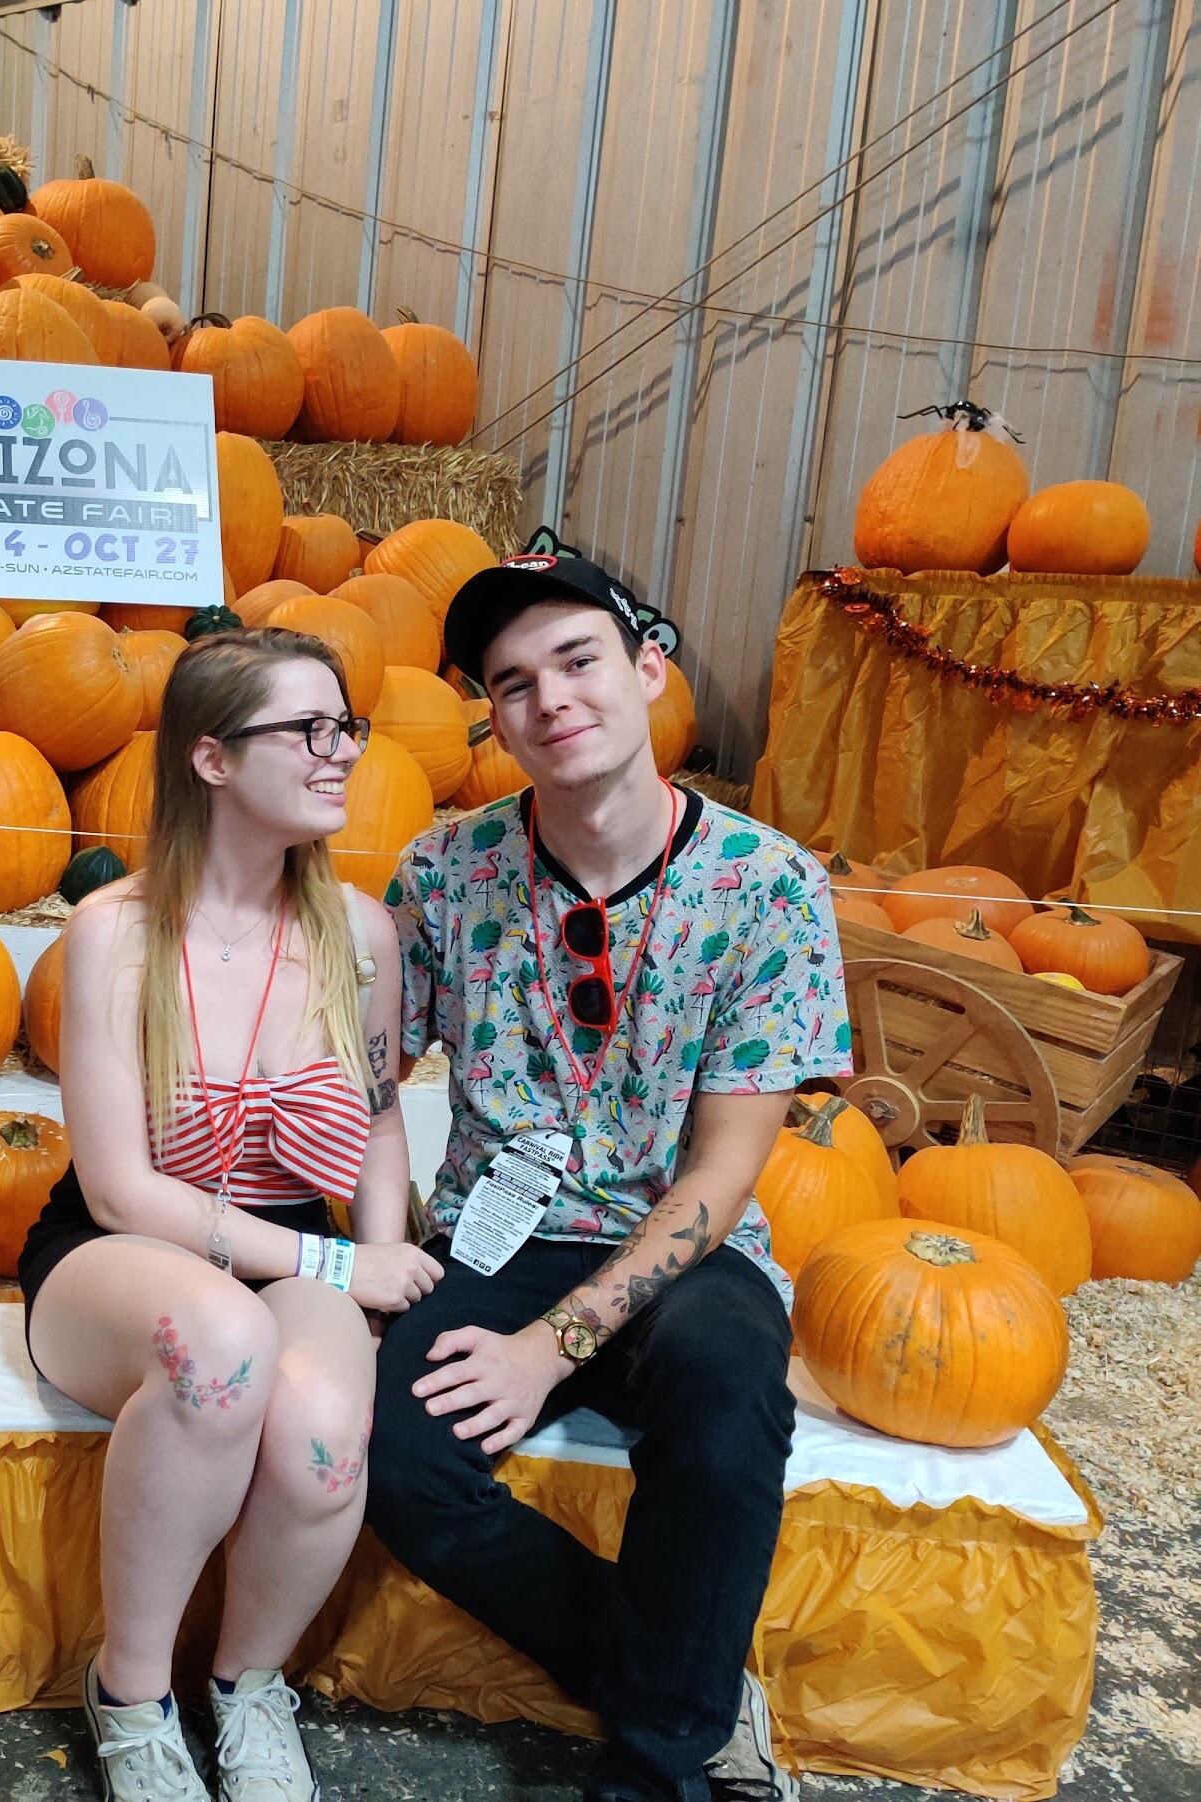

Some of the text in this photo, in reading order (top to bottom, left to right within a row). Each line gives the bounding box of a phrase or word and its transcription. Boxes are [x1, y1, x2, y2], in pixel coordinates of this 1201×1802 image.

[82, 503, 173, 526] FAIR
[4, 529, 27, 557] 4
[64, 532, 140, 563] OCT
[155, 536, 199, 566] 27
[51, 565, 199, 582] AZSTATEFAIR.COM
[517, 1136, 548, 1154] CARNIVAL
[548, 1150, 564, 1162] RIDE
